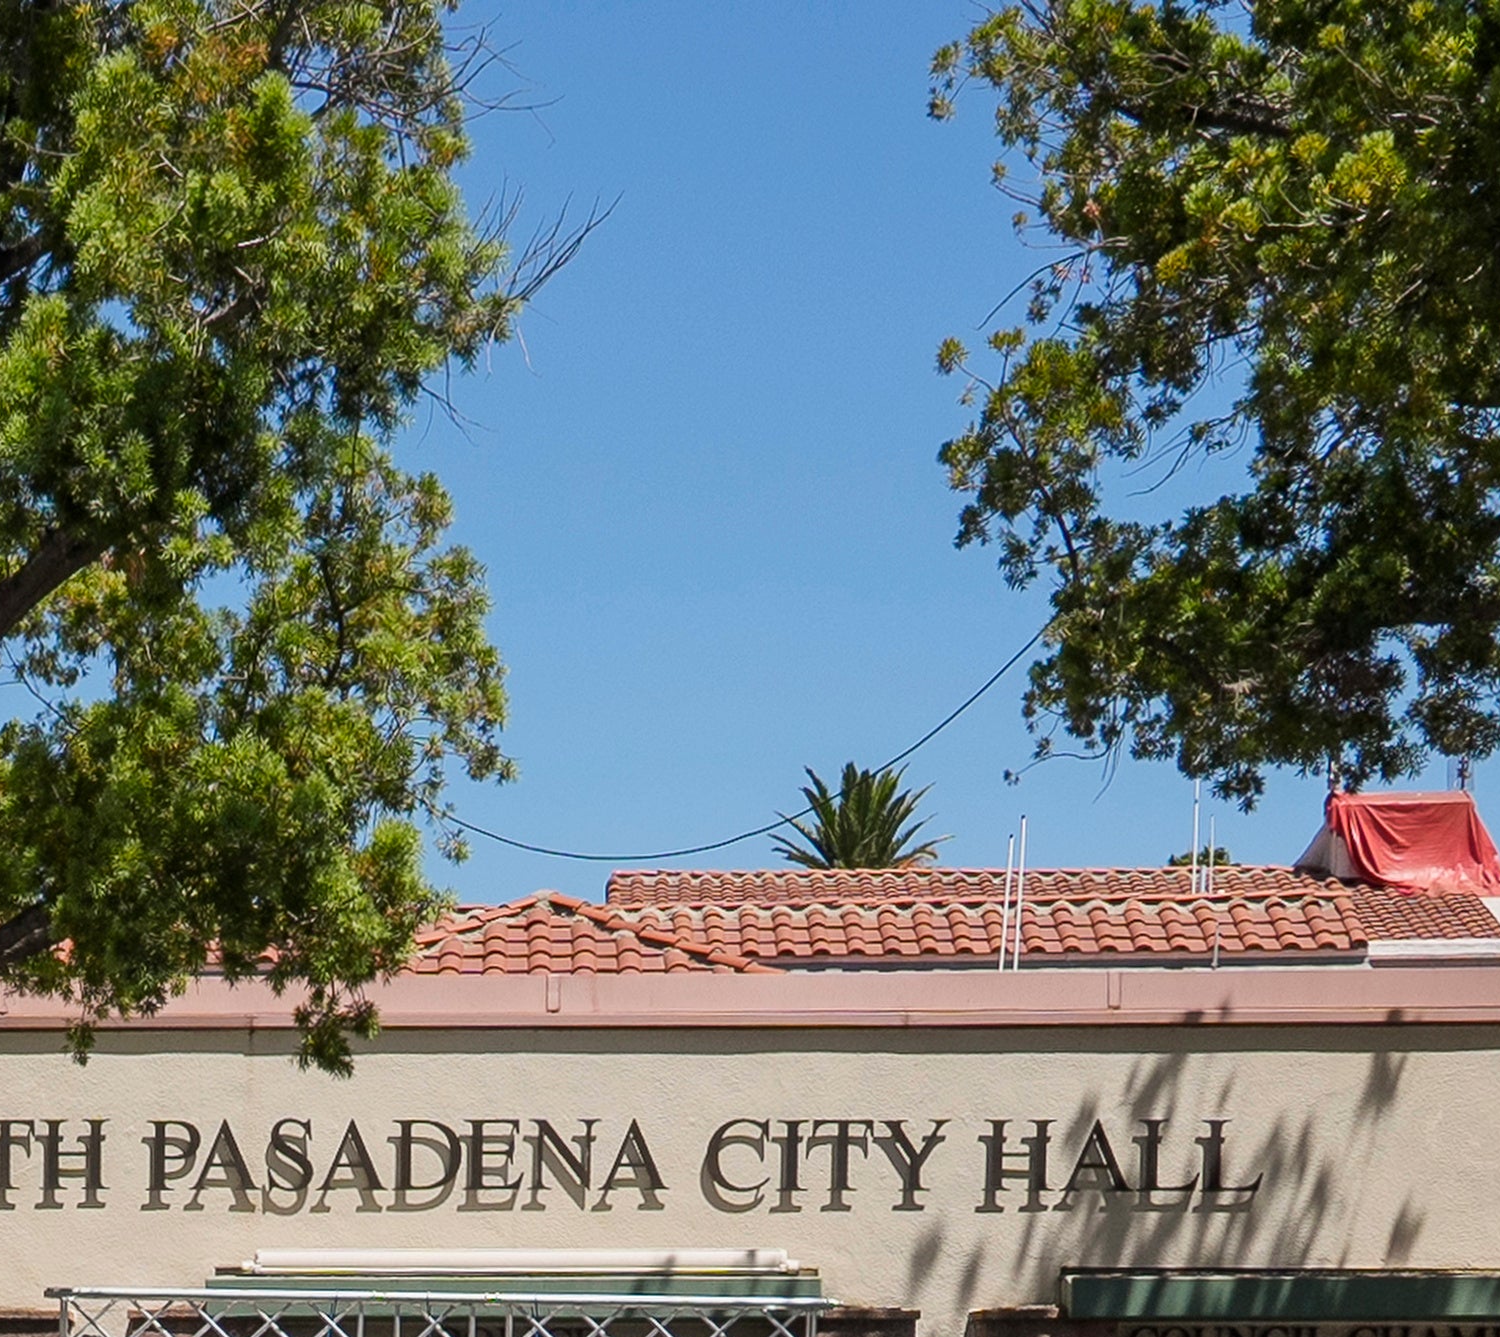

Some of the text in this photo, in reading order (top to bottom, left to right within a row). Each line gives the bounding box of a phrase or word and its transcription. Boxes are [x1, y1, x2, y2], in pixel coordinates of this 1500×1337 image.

[143, 1117, 670, 1210] PASADENA
[701, 1117, 951, 1208] CITY
[975, 1117, 1264, 1209] HALL
